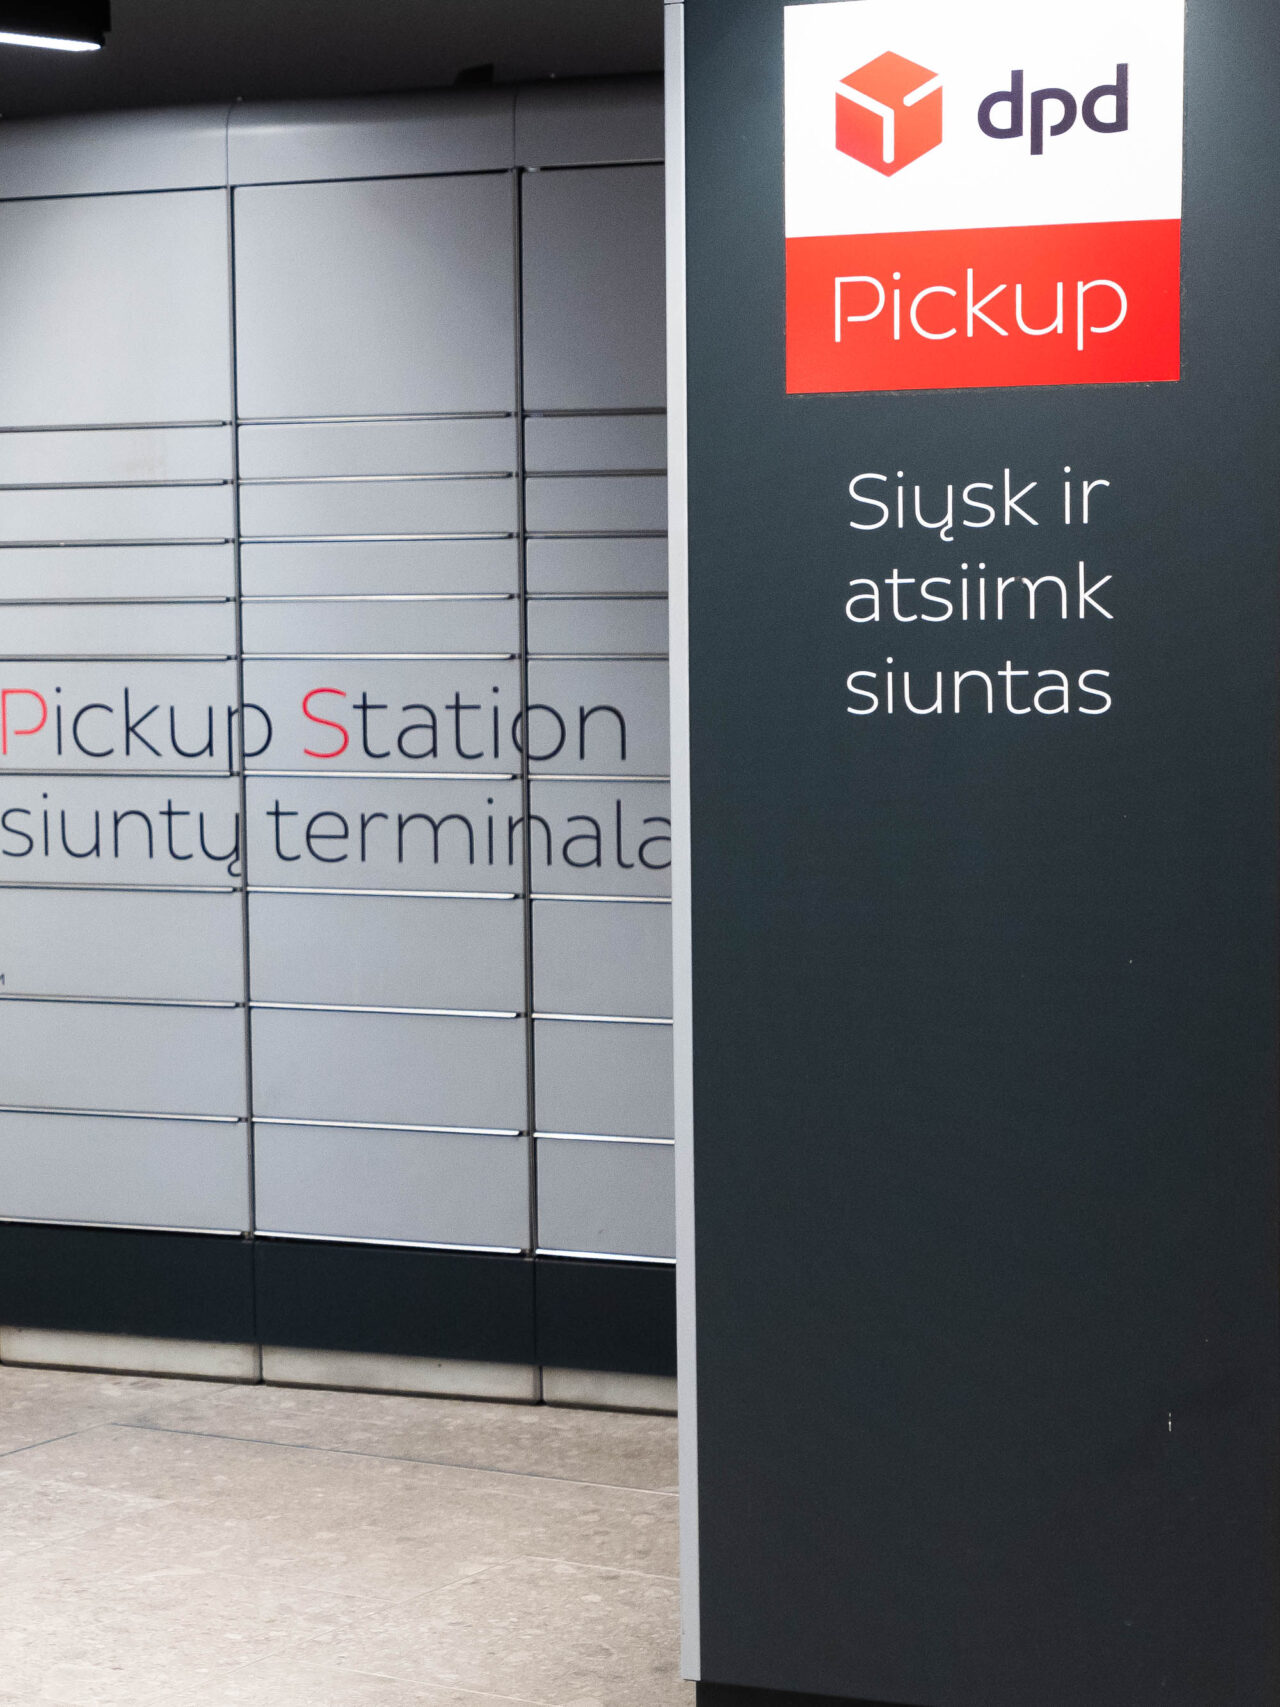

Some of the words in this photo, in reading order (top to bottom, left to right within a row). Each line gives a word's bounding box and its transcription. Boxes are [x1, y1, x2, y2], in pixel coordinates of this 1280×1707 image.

[978, 63, 1129, 156] dpd
[833, 267, 1128, 352] Pickup
[848, 467, 1039, 542] Siųsk
[1063, 465, 1111, 525] ir
[845, 560, 1114, 623] atsiimk
[846, 656, 1112, 715] siuntas
[0, 687, 273, 774] Pickup
[301, 685, 627, 762] Station
[1, 791, 243, 877] siuntų
